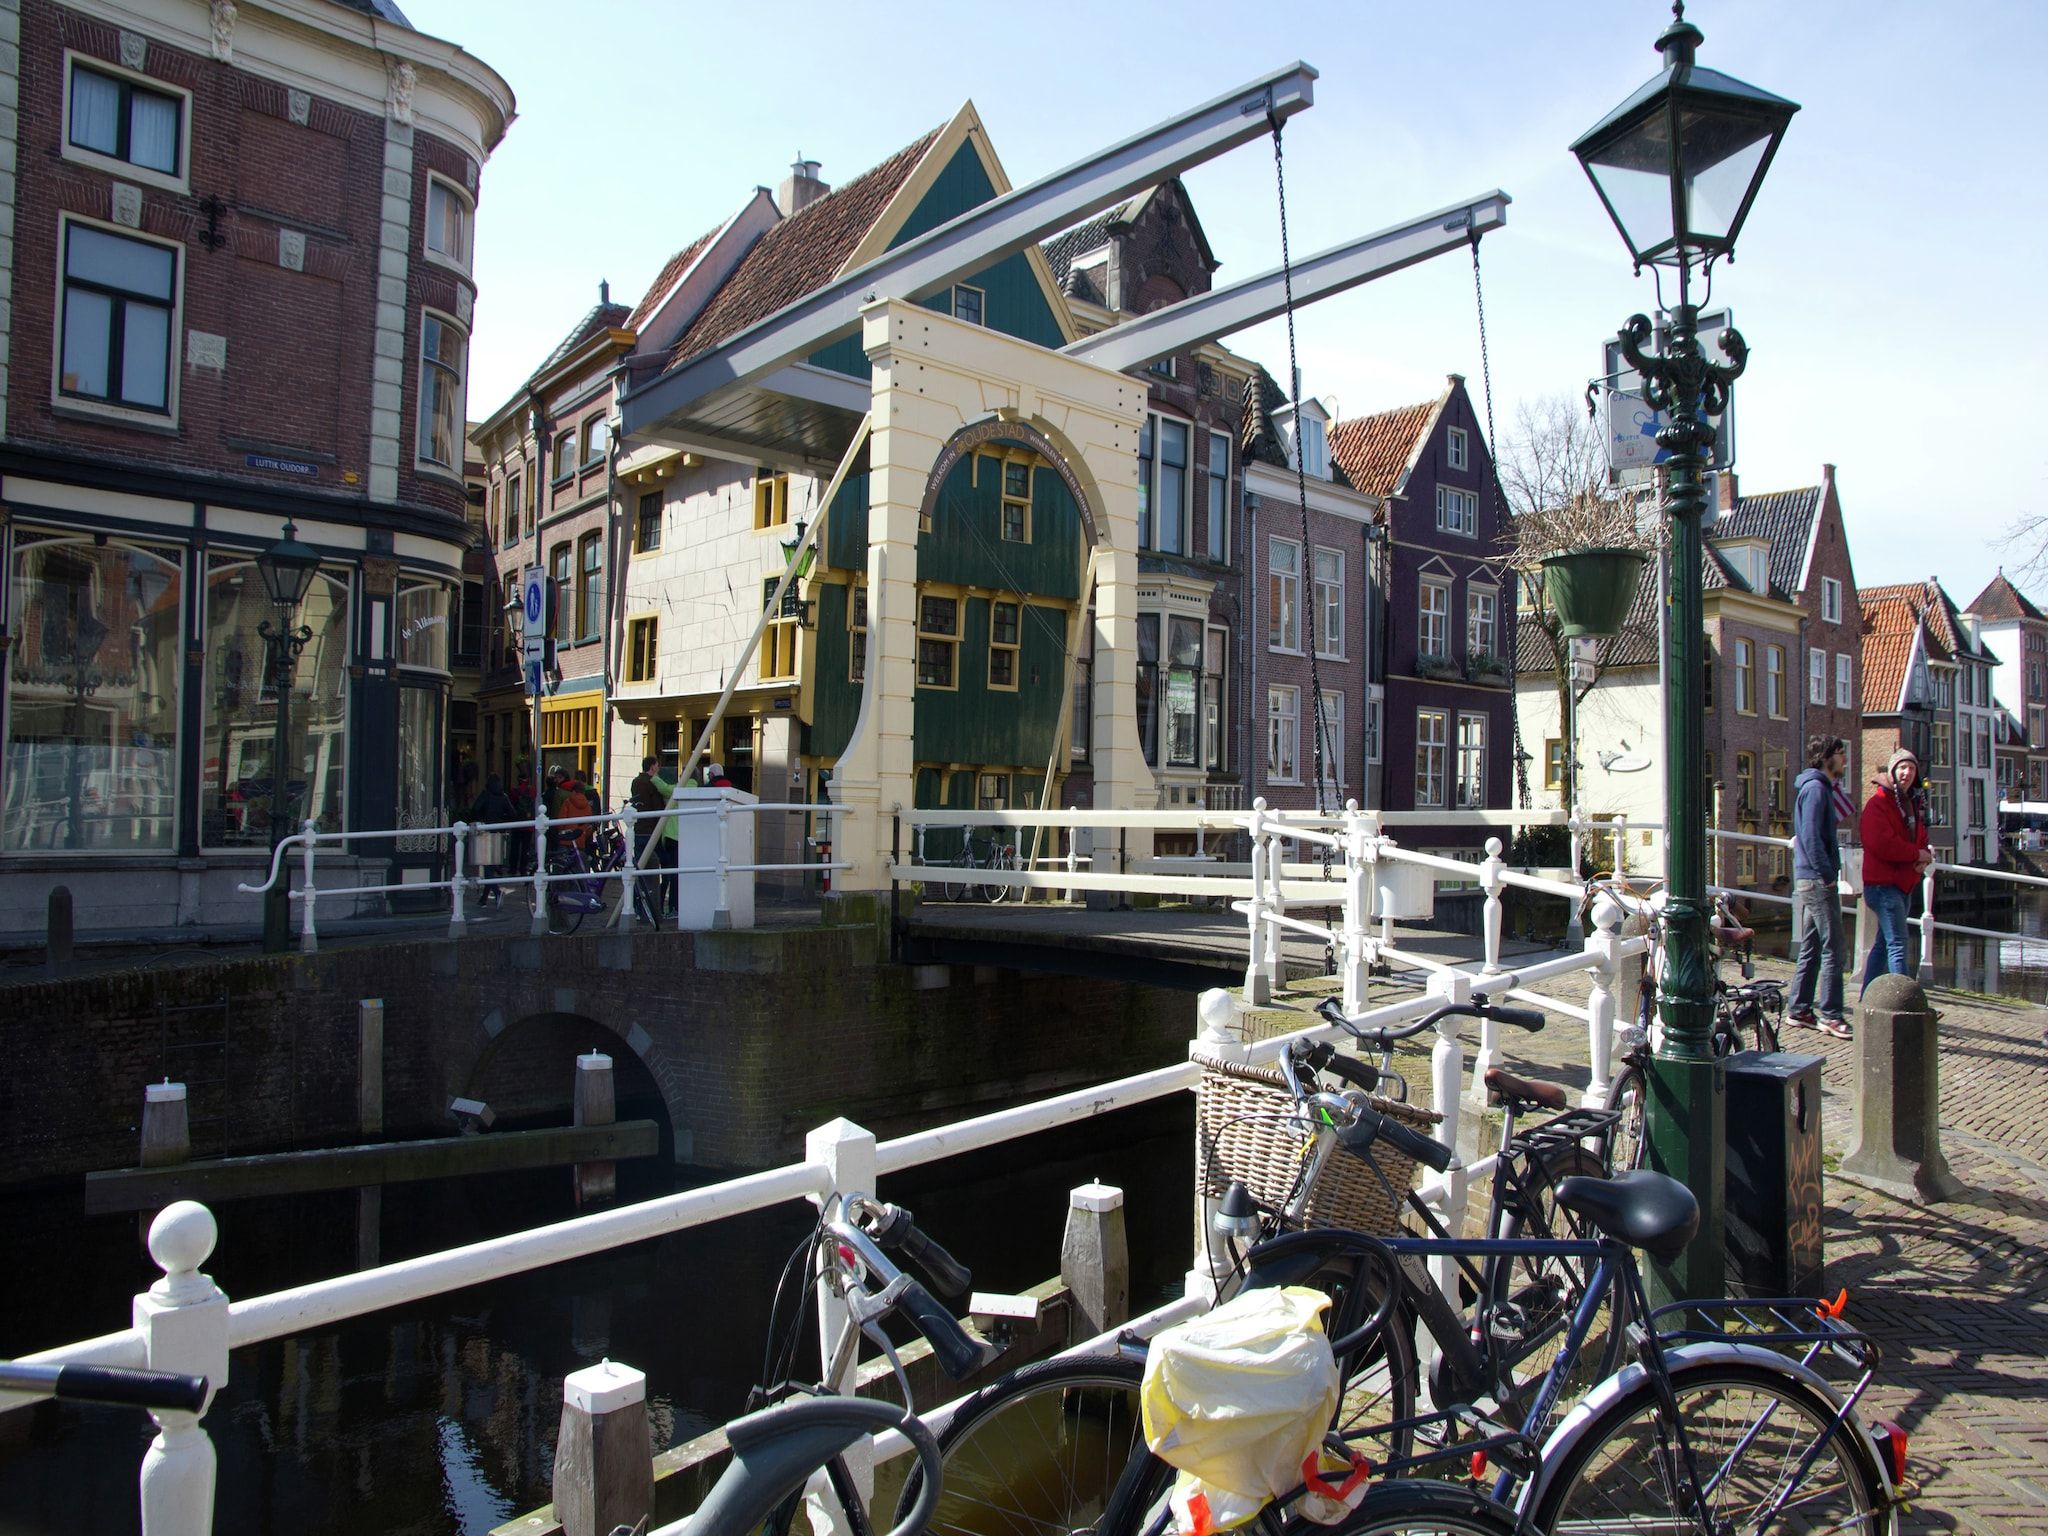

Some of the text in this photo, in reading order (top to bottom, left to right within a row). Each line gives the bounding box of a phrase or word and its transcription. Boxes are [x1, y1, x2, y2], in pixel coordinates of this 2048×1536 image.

[255, 458, 309, 474] LUTTIK OUDORP
[930, 459, 951, 490] WELKOM
[948, 450, 956, 461] IN
[1057, 458, 1071, 477] ETEN
[1069, 476, 1078, 489] EN
[1075, 488, 1093, 524] DRINKEN
[1529, 1364, 1568, 1439] GAZELLE
